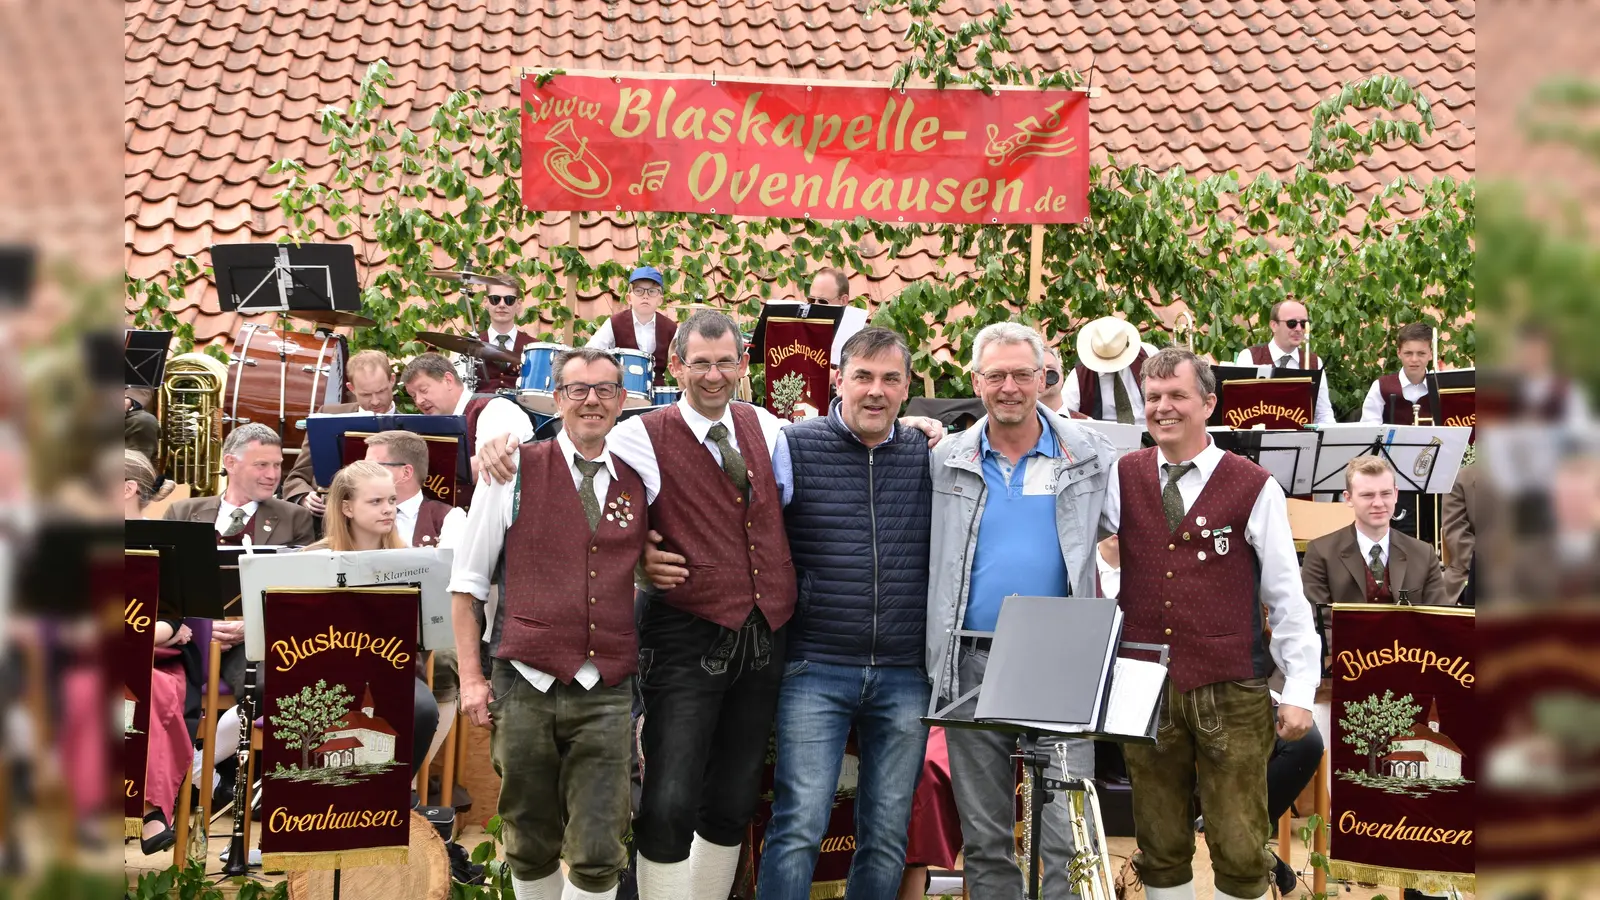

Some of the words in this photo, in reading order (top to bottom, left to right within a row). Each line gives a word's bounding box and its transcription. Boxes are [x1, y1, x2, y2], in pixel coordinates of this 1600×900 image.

[610, 86, 967, 162] Blaskapelle-
[767, 338, 829, 369] Blaskapelle
[1225, 399, 1309, 431] Blaskapelle
[271, 624, 411, 672] Blaskapelle
[1337, 639, 1475, 689] Blaskapelle
[269, 804, 403, 834] Ovenhausen
[1338, 810, 1474, 846] Ovenhausen
